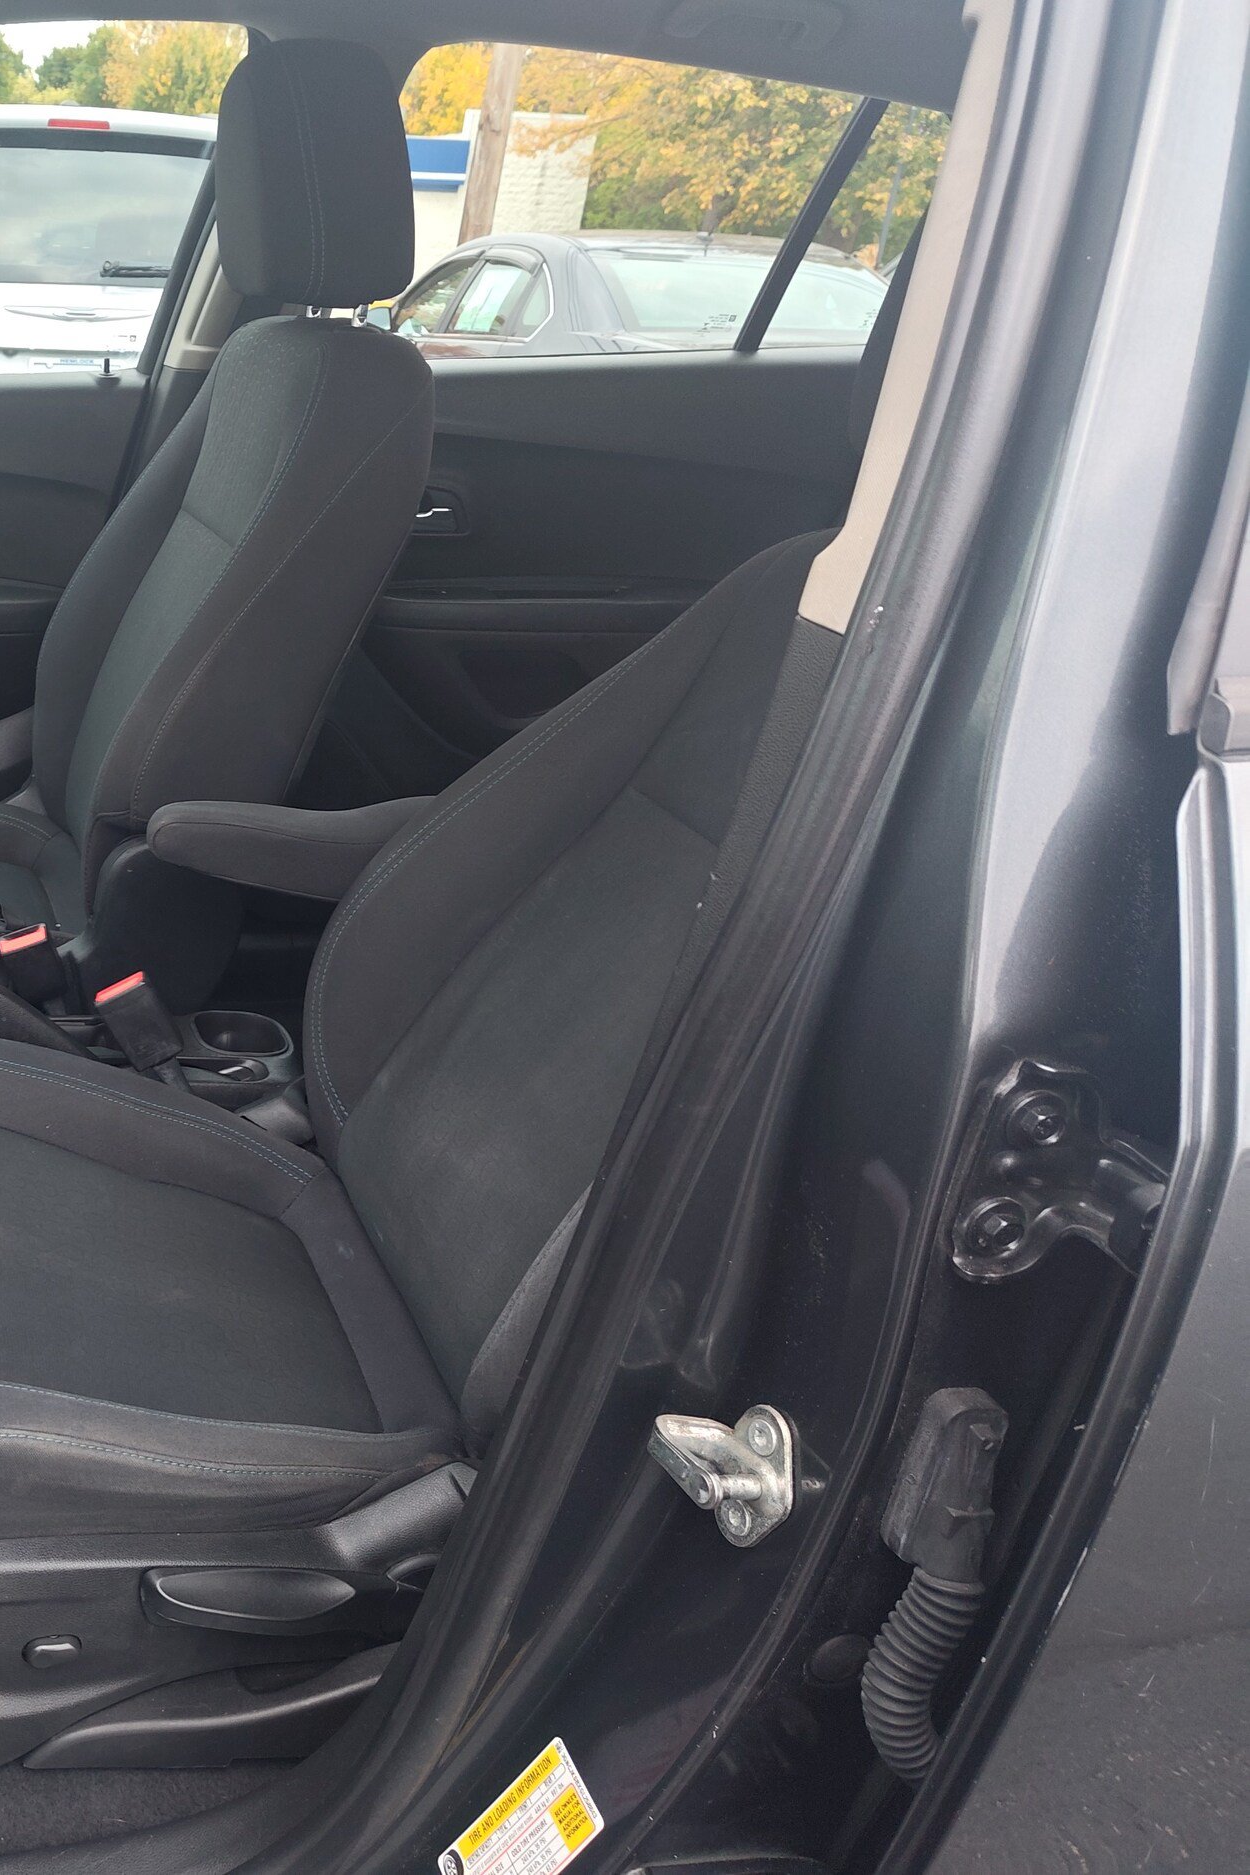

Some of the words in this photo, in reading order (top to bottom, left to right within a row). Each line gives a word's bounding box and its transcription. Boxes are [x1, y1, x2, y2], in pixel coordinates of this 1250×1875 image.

[467, 1826, 482, 1846] TIRE
[479, 1814, 494, 1833] AND
[491, 1791, 517, 1821] LOADING
[516, 1756, 552, 1798] INFORMATION
[554, 1807, 562, 1817] SEE
[560, 1792, 576, 1811] OWNER'S
[557, 1807, 572, 1825] MANUAL
[571, 1799, 580, 1810] FOR
[561, 1807, 584, 1832] ADDITIONAL
[565, 1814, 588, 1840] INFORMATION
[510, 1843, 521, 1858] COLD
[519, 1835, 529, 1848] TIRE
[528, 1817, 547, 1840] PRESSURE
